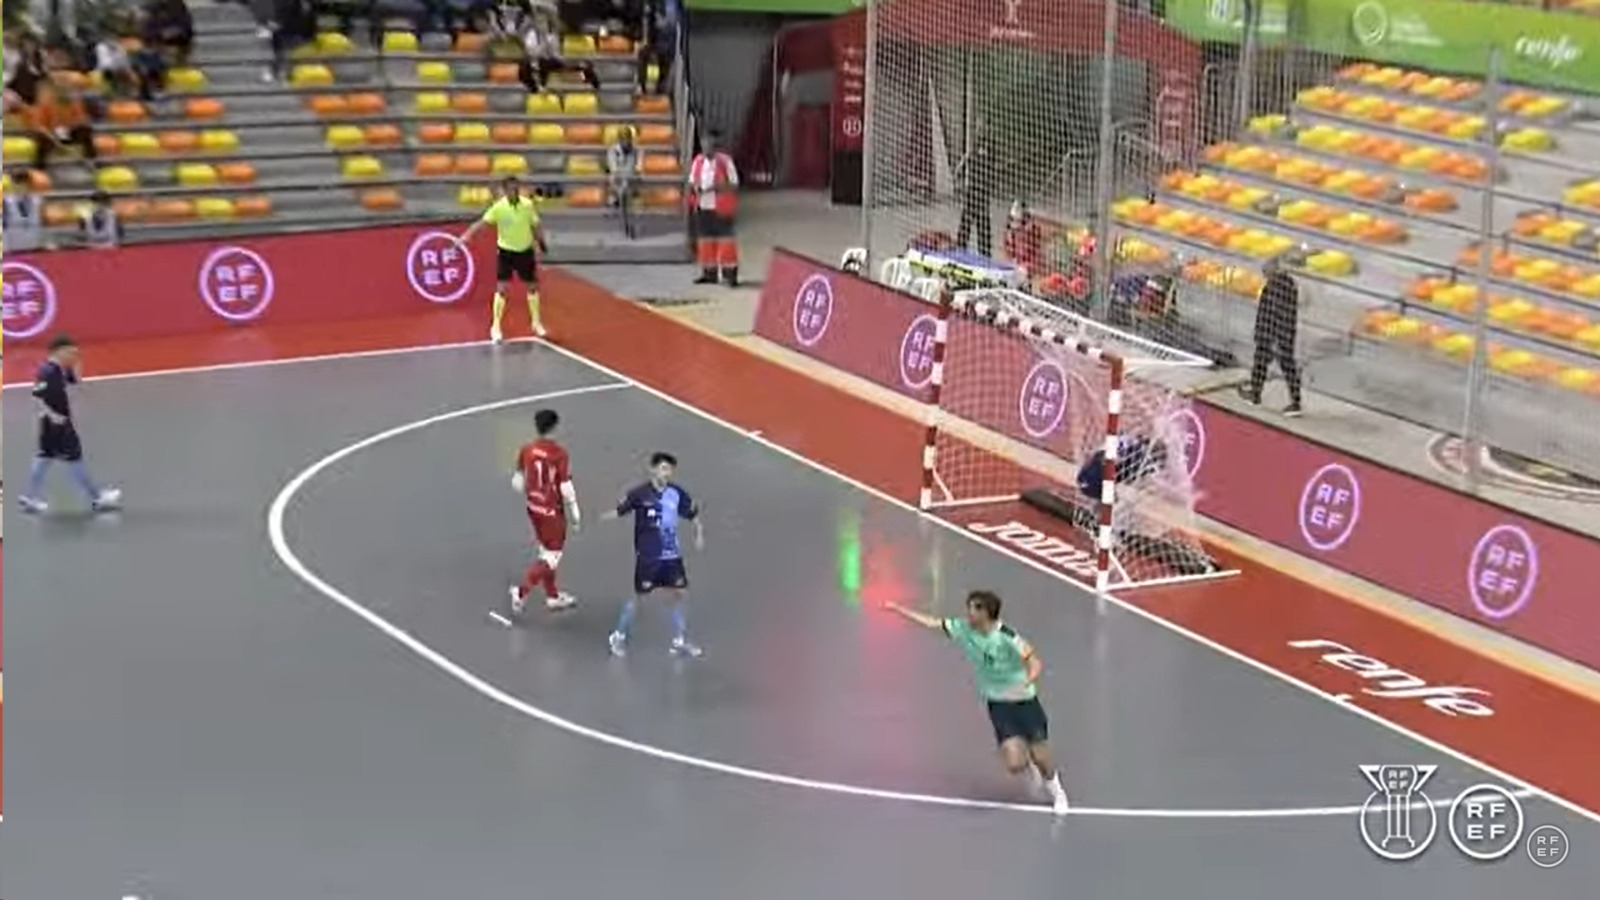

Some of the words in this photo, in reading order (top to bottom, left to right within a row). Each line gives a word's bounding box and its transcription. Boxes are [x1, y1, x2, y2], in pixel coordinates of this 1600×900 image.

[421, 248, 459, 266] RF
[215, 264, 256, 281] RF
[424, 268, 459, 285] EF
[218, 285, 257, 302] EF
[803, 289, 826, 308] RF
[800, 310, 821, 328] EF
[911, 331, 935, 351] RF
[1033, 376, 1060, 396] RF
[1027, 396, 1054, 417] EF
[1316, 484, 1350, 505] RF
[1310, 506, 1344, 529] EF
[1486, 544, 1525, 570] RF
[1479, 570, 1518, 594] EF
[1287, 638, 1495, 716] renfe
